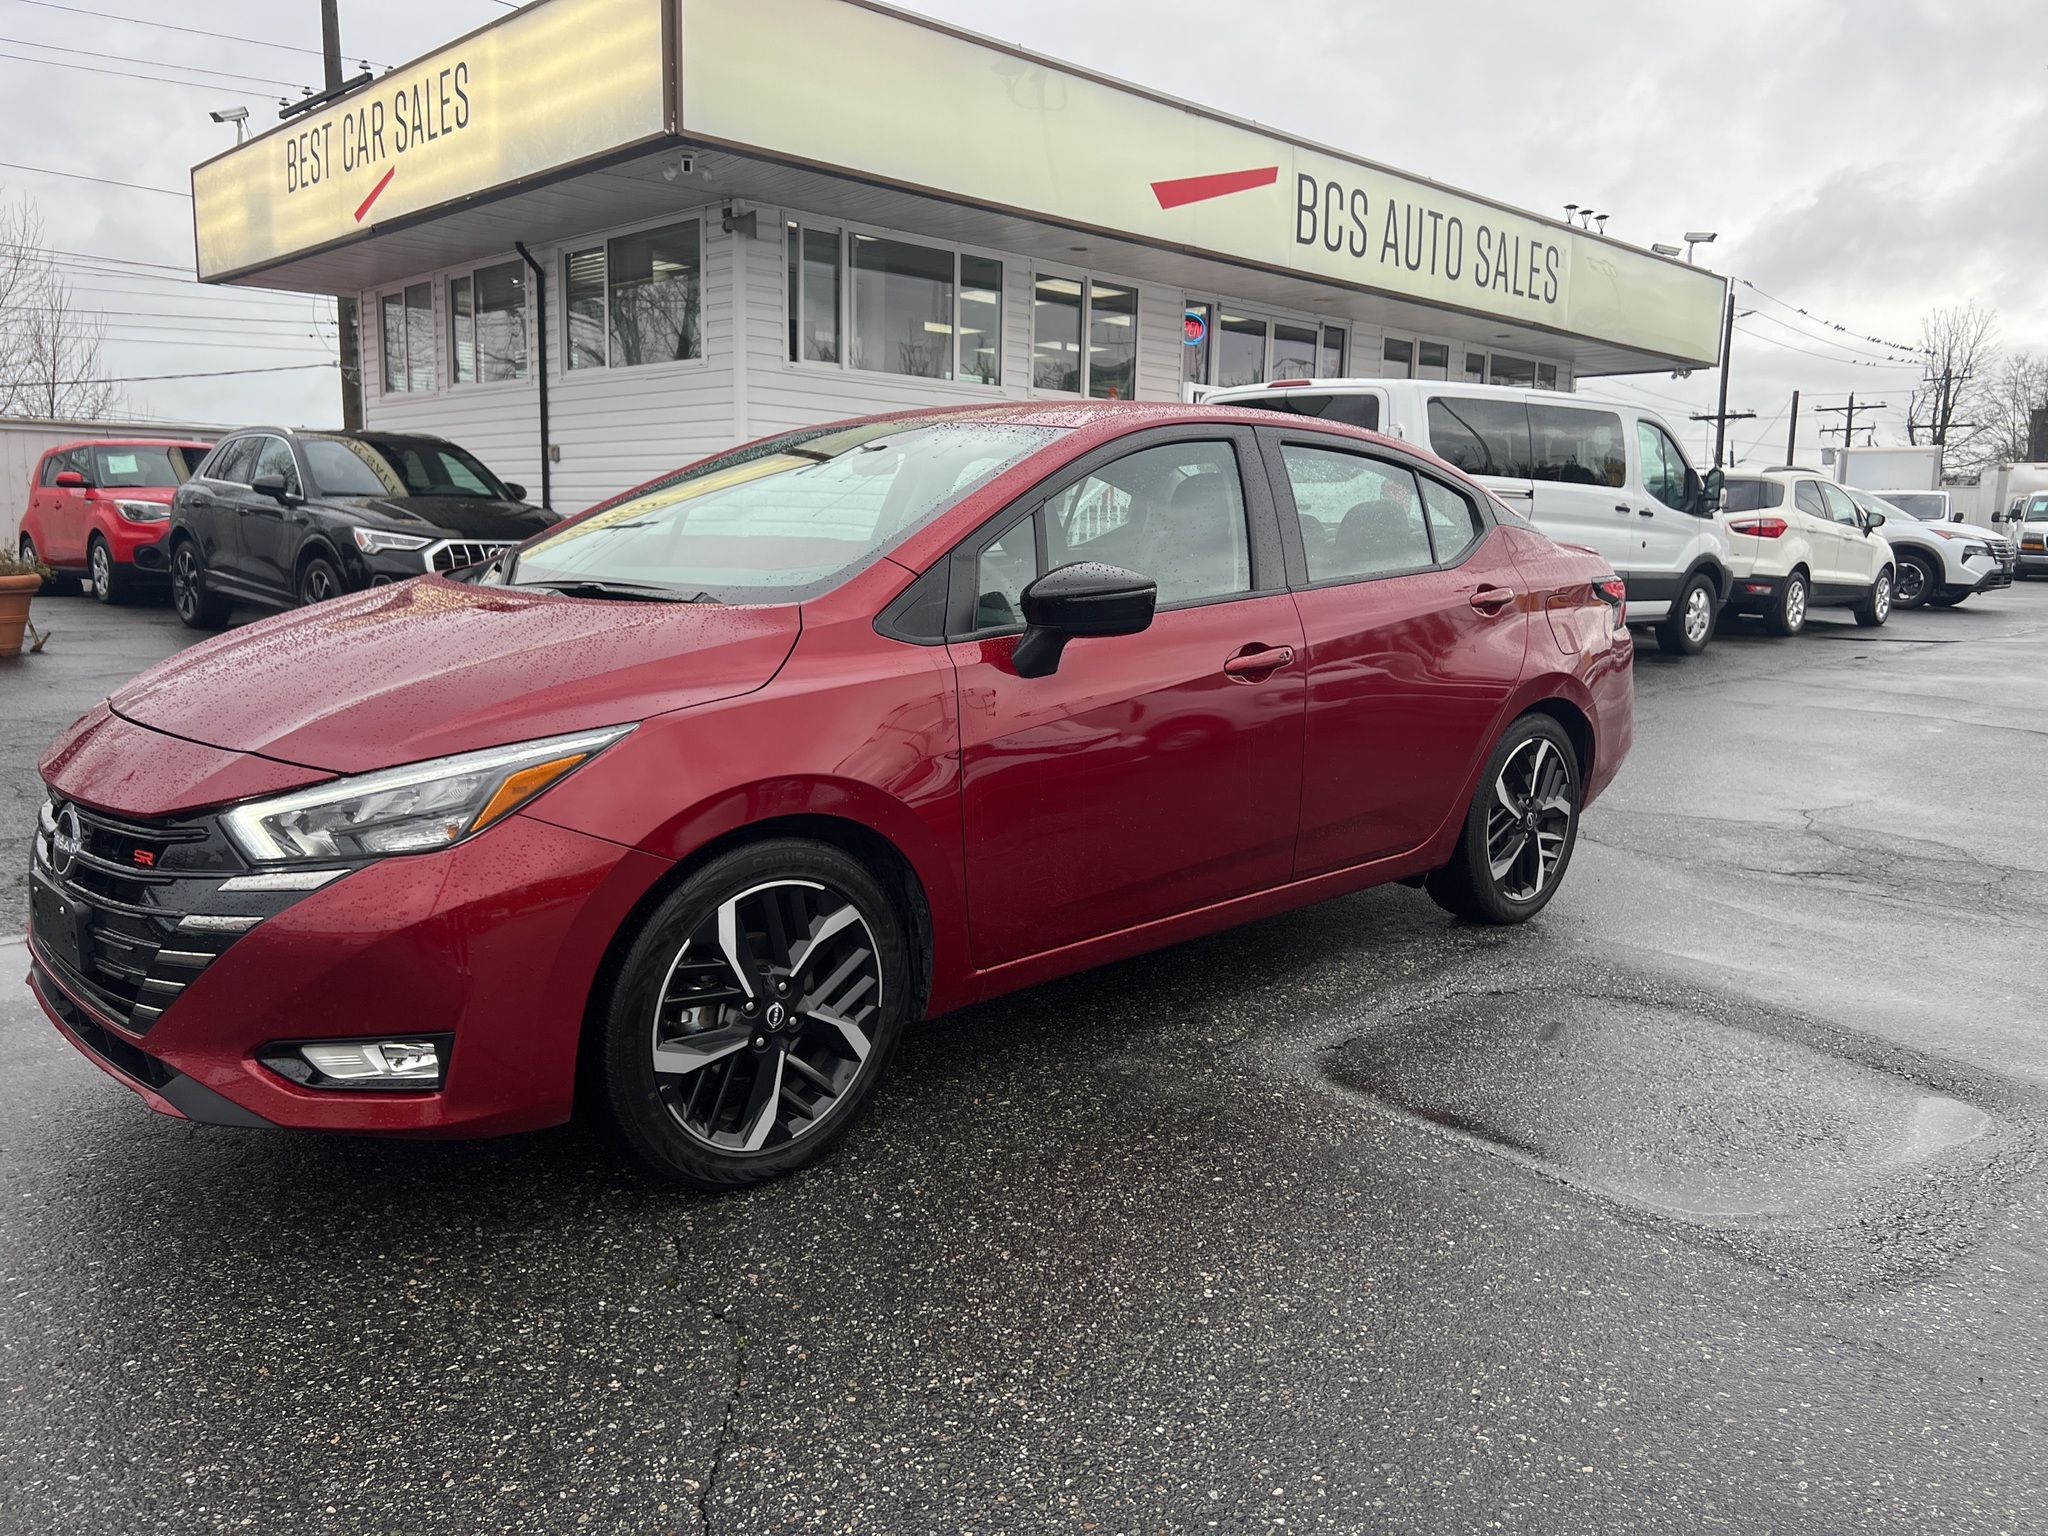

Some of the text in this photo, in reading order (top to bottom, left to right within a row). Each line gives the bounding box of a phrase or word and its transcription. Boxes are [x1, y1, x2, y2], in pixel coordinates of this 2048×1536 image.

[287, 62, 469, 193] BEST CAR SALES
[1296, 173, 1559, 304] BCS AUTO SALES
[1184, 320, 1203, 338] PEN
[133, 849, 155, 866] SR
